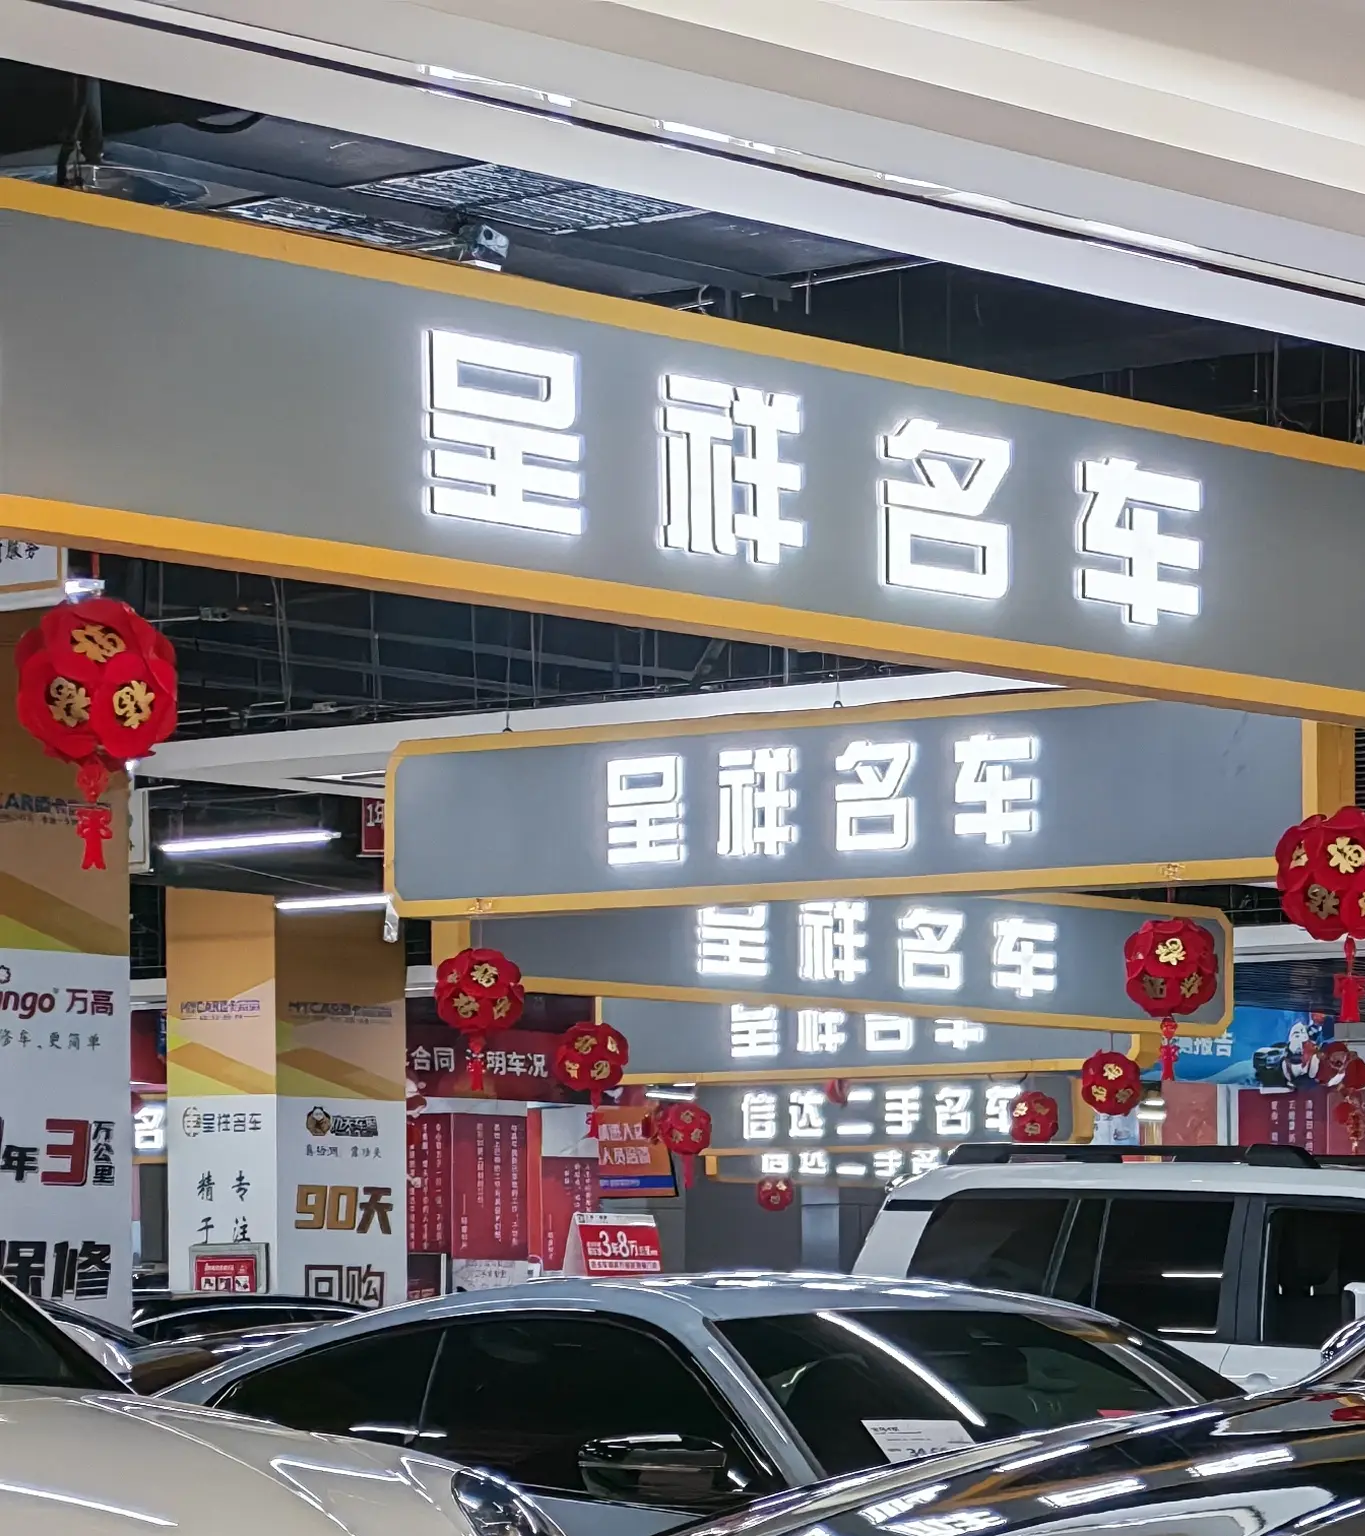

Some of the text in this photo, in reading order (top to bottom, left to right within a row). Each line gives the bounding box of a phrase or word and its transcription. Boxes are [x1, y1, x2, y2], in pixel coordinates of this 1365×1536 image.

[422, 327, 1204, 627] 呈祥名车
[606, 733, 1038, 867] 呈祥名车
[697, 900, 1058, 998] 呈祥名车
[0, 988, 114, 1020] ngo 万高
[405, 1045, 455, 1072] 合同
[134, 1104, 166, 1150] 名
[203, 1113, 262, 1133] 呈祥名车
[93, 1121, 115, 1186] 万公里
[295, 1184, 393, 1234] 90天
[305, 1264, 385, 1306] 回购
